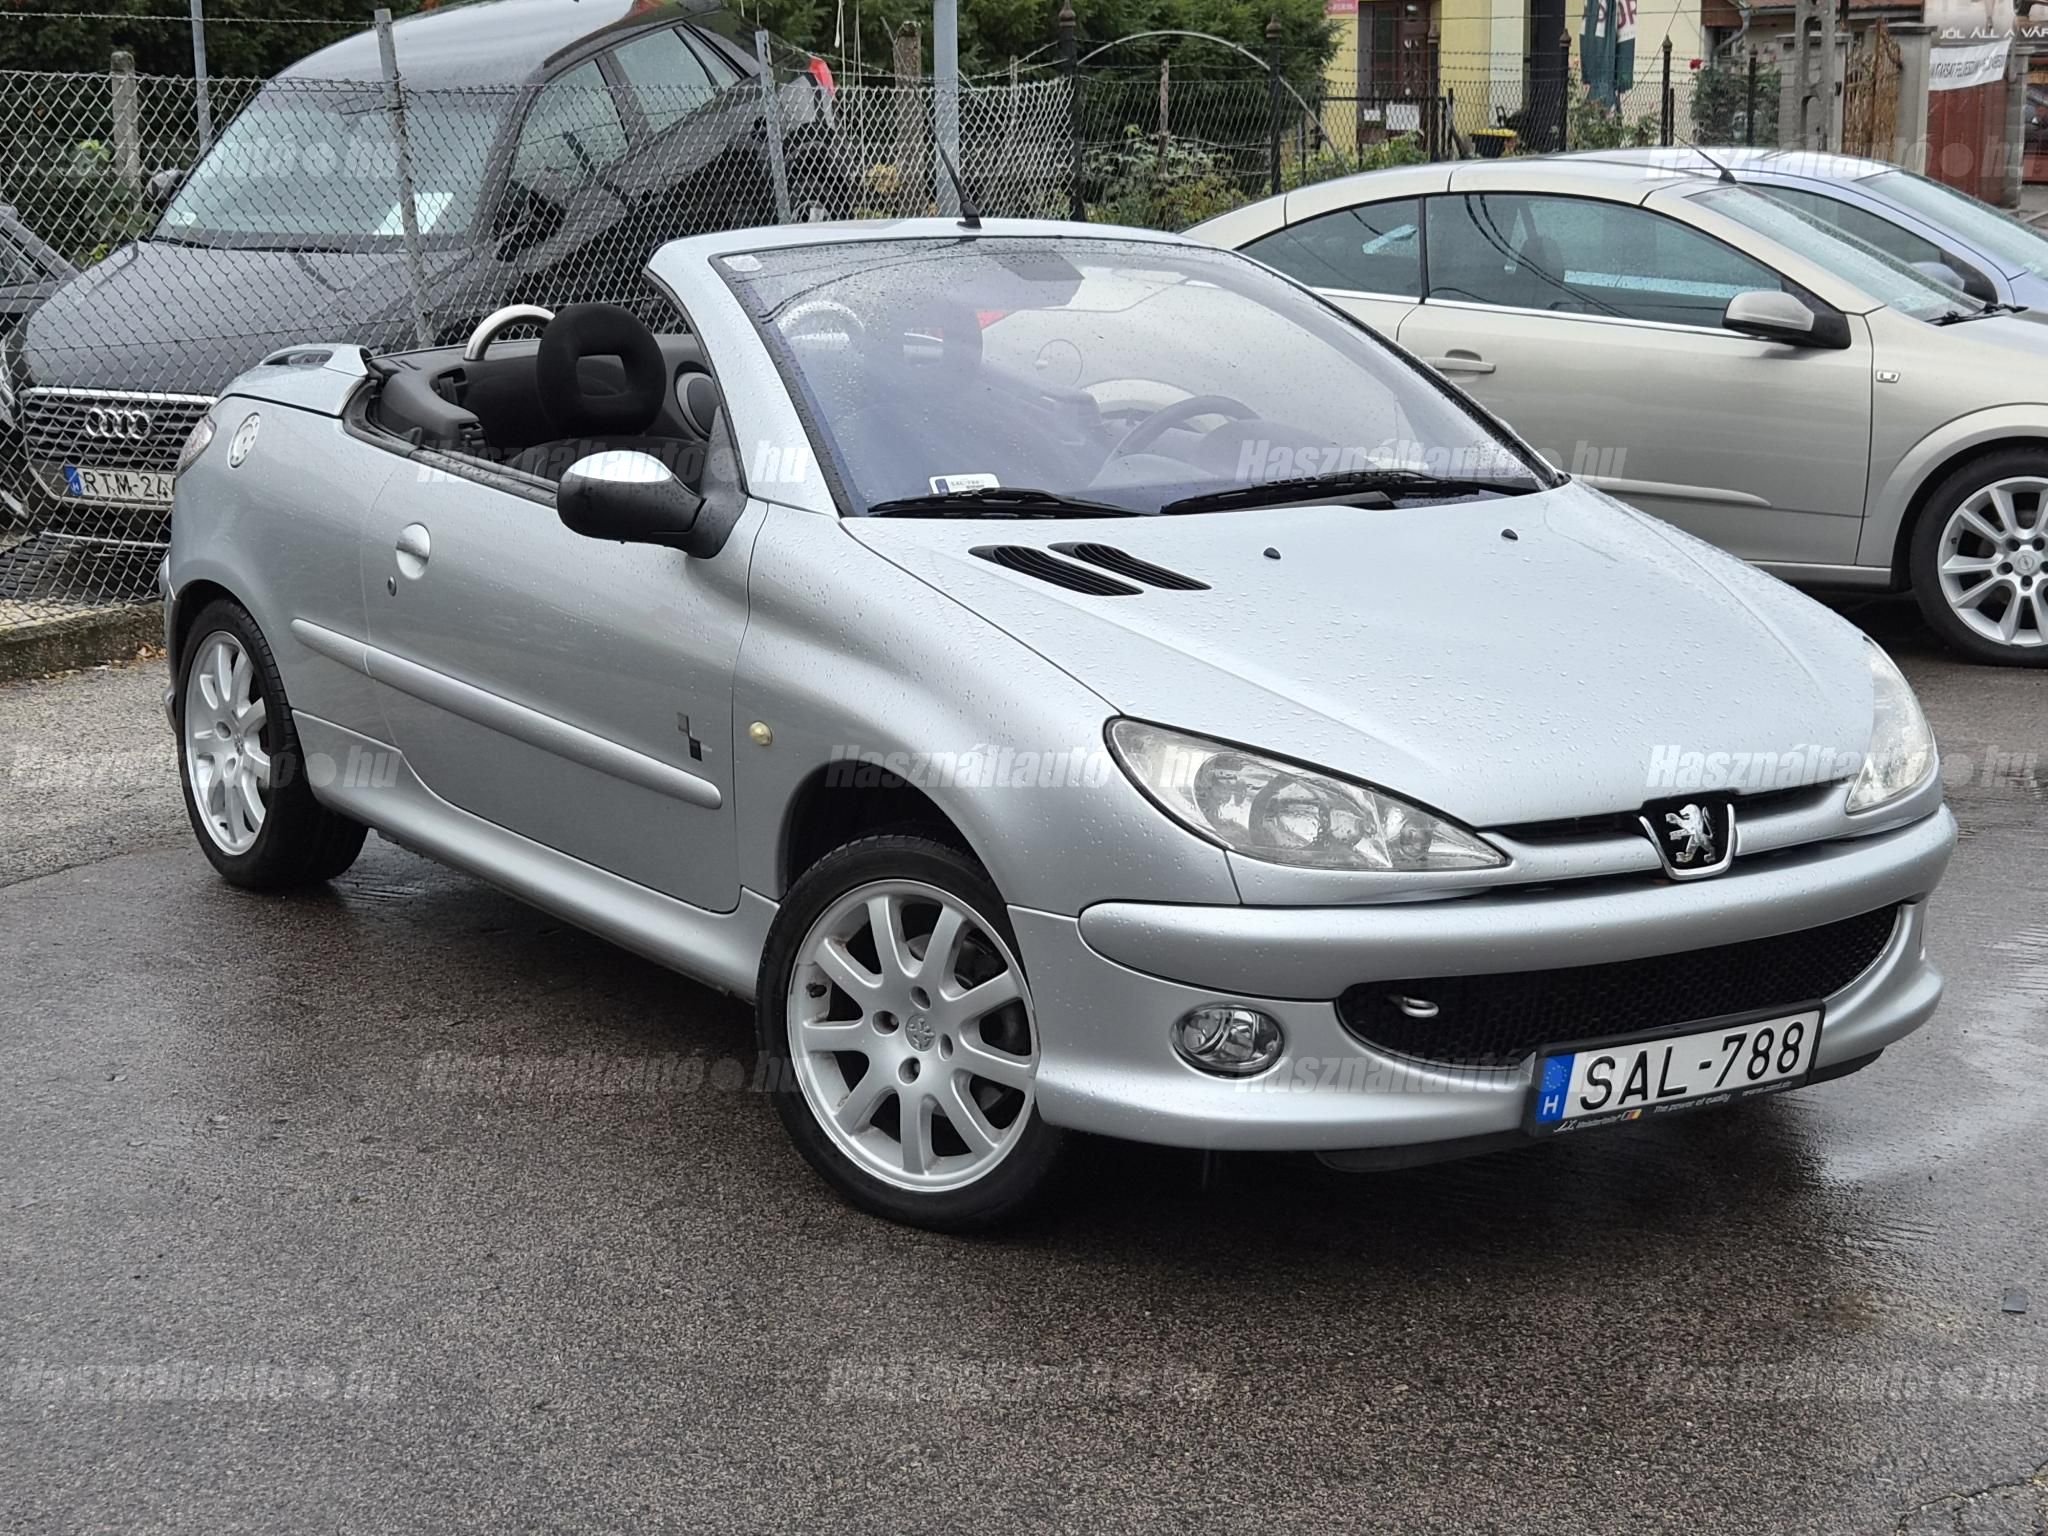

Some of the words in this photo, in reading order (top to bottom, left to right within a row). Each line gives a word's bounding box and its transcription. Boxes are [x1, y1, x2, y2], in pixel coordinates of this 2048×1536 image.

[1939, 27, 1965, 39] JÓL
[1970, 26, 1999, 39] ÁLL
[83, 471, 176, 499] RTM-24
[1579, 1020, 1804, 1111] SAL-788
[1542, 1094, 1559, 1116] H
